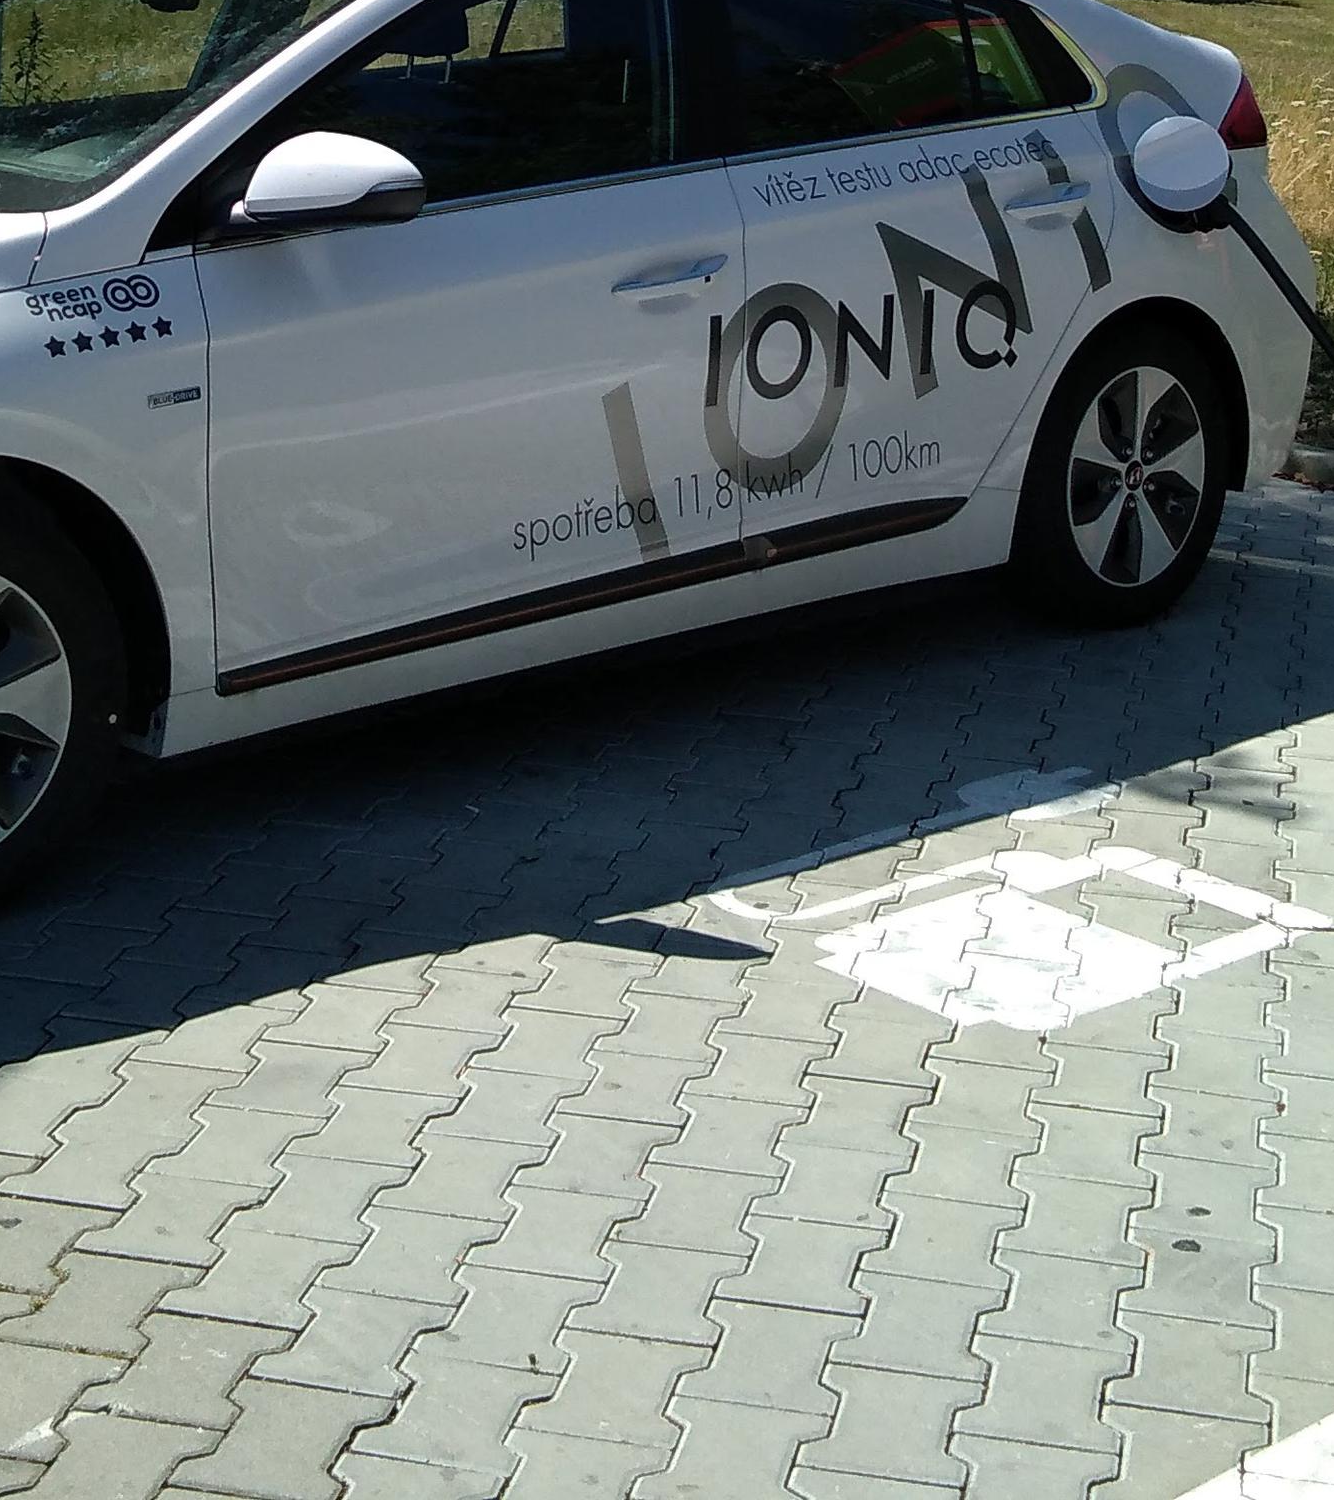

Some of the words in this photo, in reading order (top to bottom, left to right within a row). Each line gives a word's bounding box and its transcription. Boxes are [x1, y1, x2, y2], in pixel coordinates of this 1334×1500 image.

[753, 170, 828, 207] vítěz
[825, 160, 892, 196] testu
[897, 144, 970, 183] adac
[25, 284, 97, 316] green
[46, 300, 103, 322] ncap
[704, 279, 1018, 407] IONIQ
[511, 484, 659, 561] spotřeba
[673, 466, 733, 520] 11,8
[745, 450, 804, 504] kwh
[815, 443, 834, 499] /
[848, 430, 941, 482] 100km
